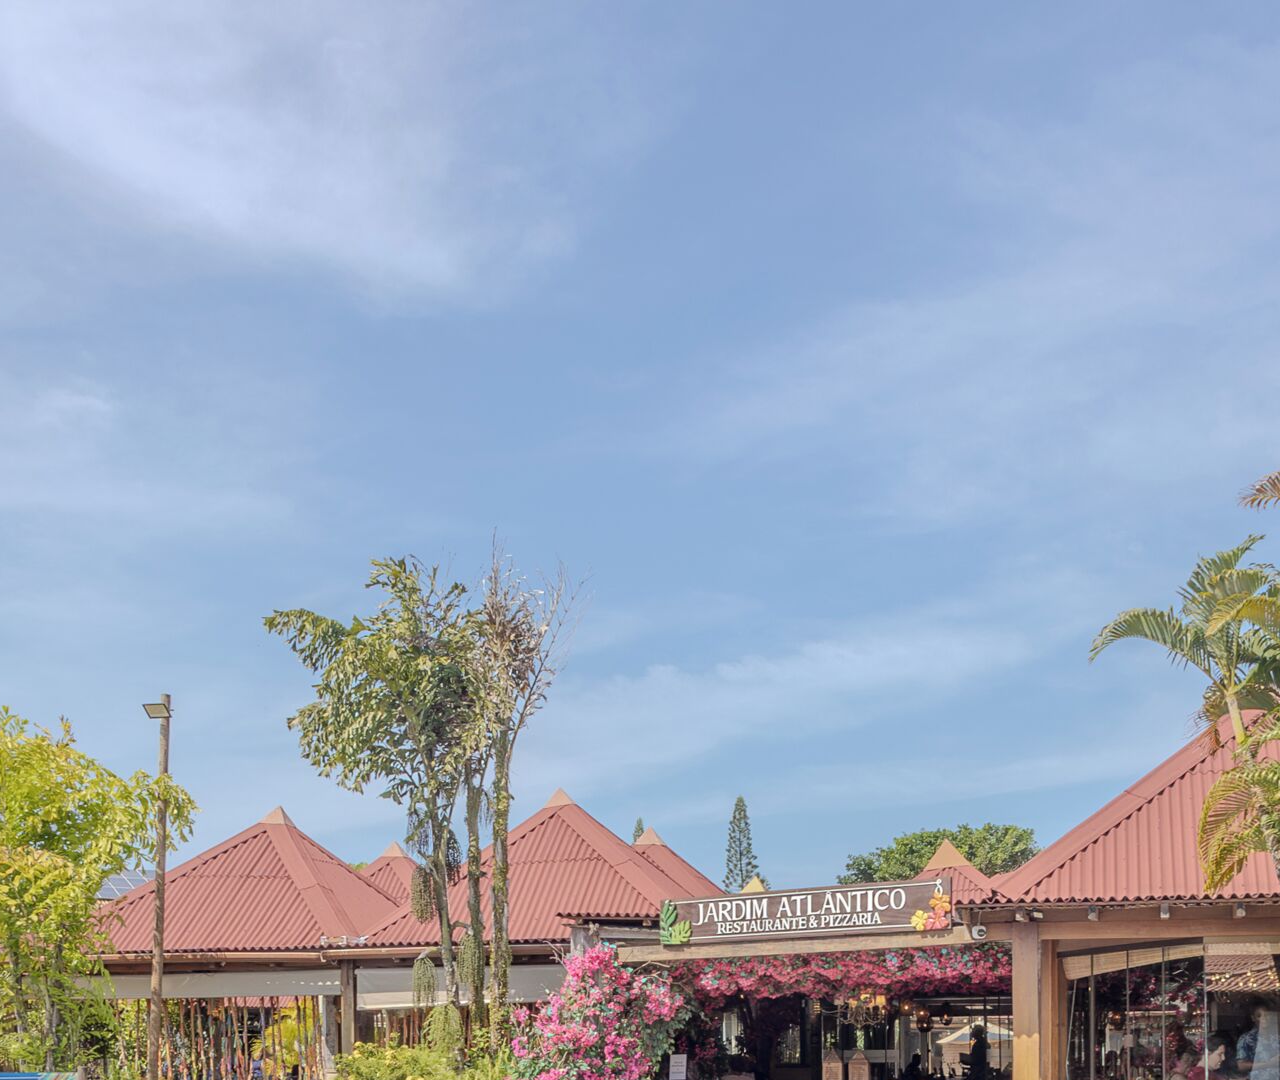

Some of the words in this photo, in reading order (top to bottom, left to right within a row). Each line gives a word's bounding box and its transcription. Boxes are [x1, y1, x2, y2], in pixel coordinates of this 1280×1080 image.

[693, 898, 768, 926] JARDIM
[776, 888, 906, 918] ATLÂNTICO
[716, 916, 807, 935] RESTAURANTE
[809, 916, 818, 928] &
[821, 911, 882, 928] PIZZARIA
